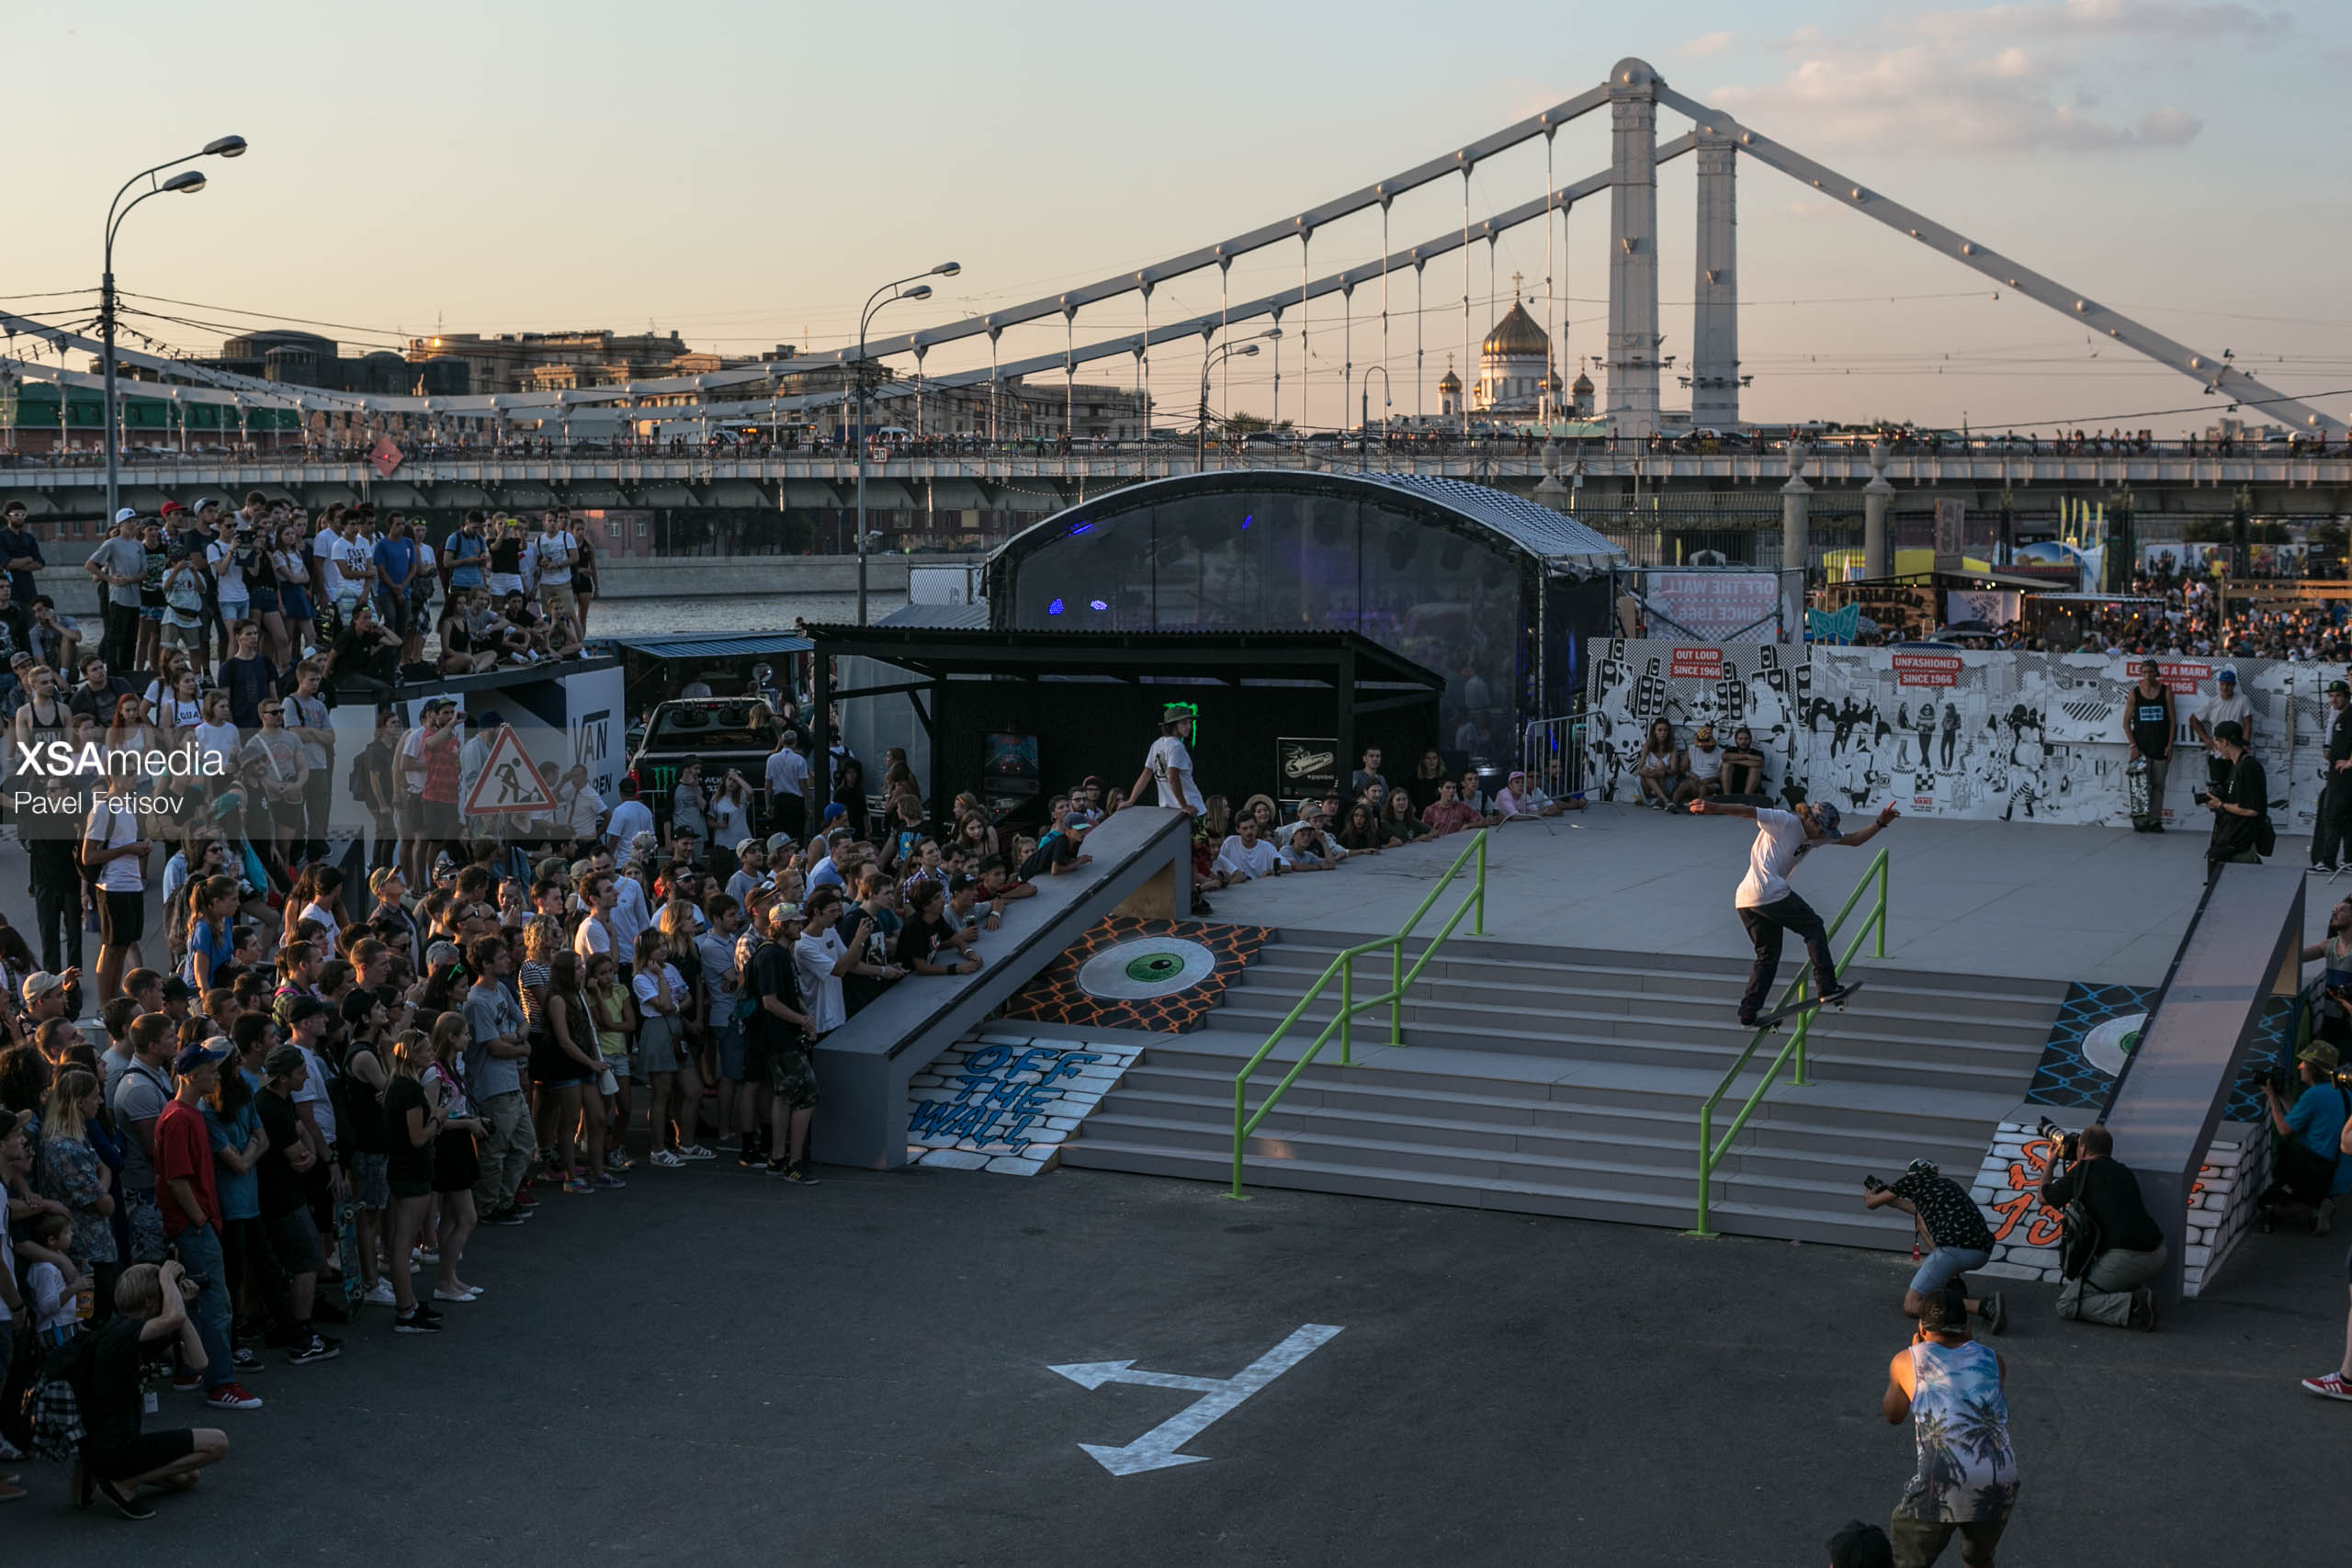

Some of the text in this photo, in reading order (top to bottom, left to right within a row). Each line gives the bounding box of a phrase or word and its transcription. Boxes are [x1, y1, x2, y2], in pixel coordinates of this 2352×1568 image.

[875, 449, 886, 460] 90
[1676, 649, 1719, 660] OUT LOUD
[1894, 658, 1959, 670] UNFASHIONED
[1673, 665, 1721, 677] SINCE 1966
[2180, 668, 2208, 677] MARK
[1902, 673, 1953, 685] SINCE 1966
[964, 1044, 1102, 1085] OFF
[956, 1075, 1066, 1120] THE
[908, 1100, 1035, 1154] WALL
